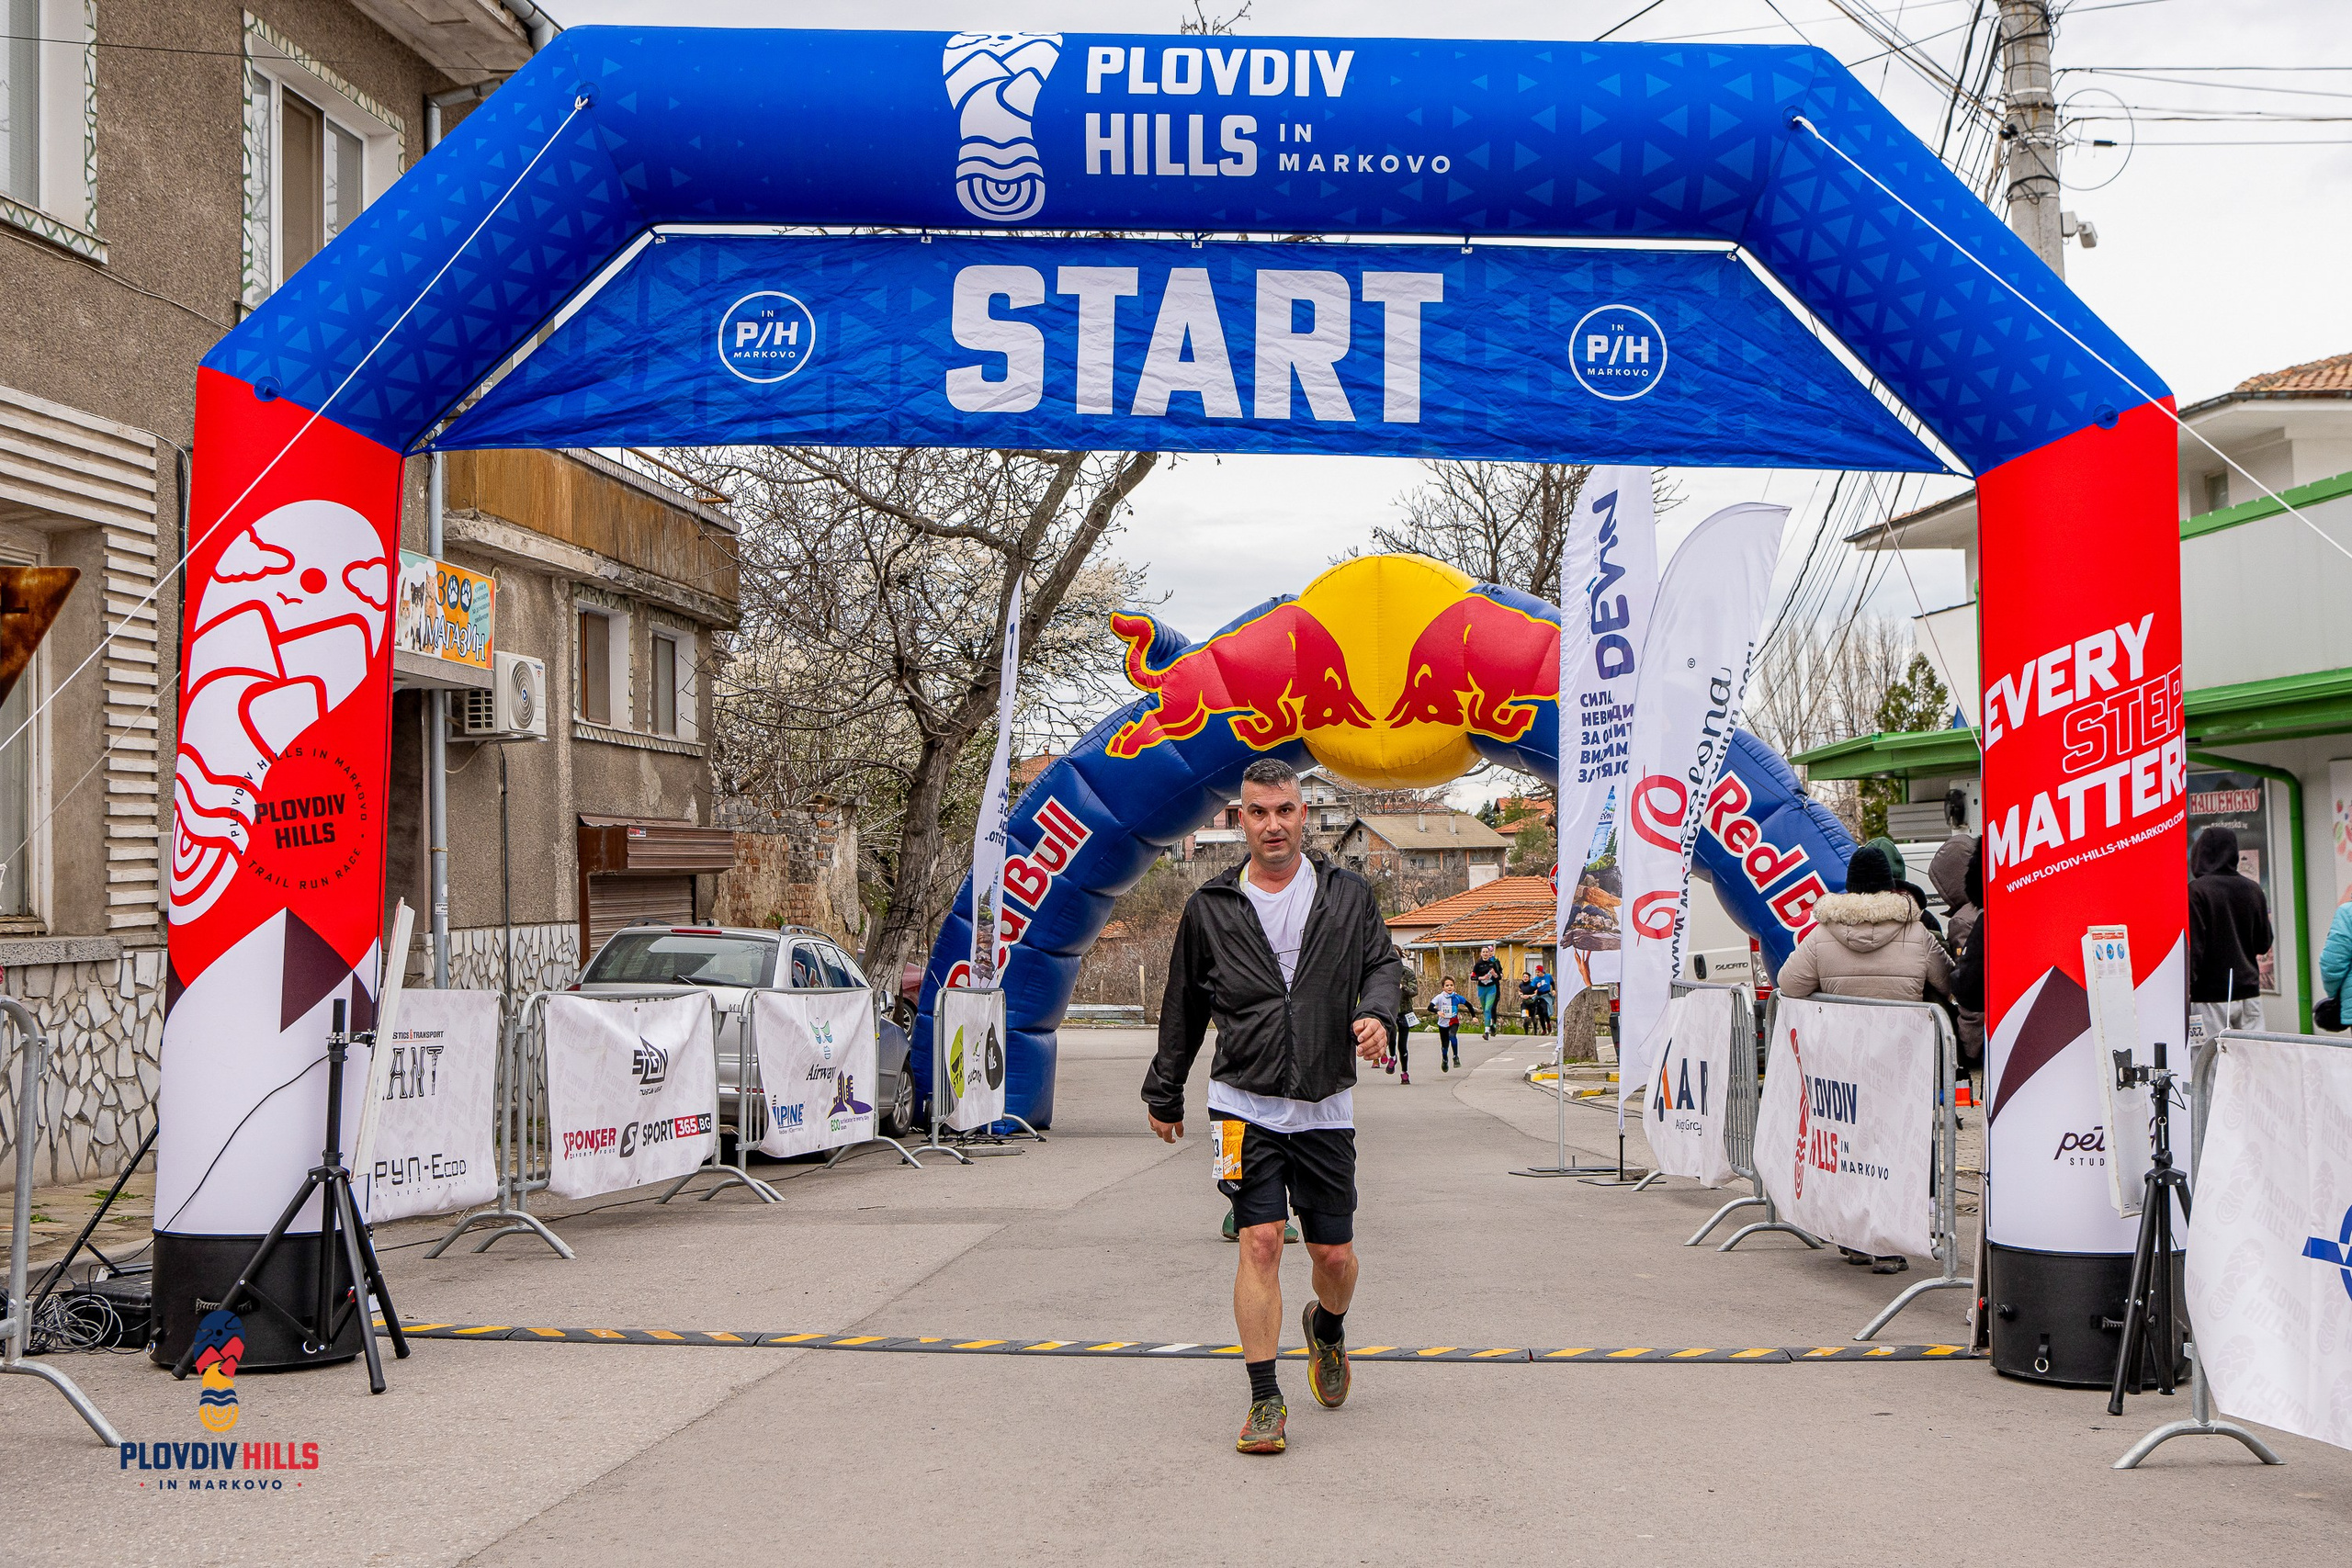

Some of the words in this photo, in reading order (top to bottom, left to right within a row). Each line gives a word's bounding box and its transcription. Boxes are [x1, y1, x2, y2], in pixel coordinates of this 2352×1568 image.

[1086, 46, 1355, 97] PLOVDIV
[1085, 113, 1258, 177] HILLS
[1279, 123, 1313, 143] IN
[1279, 153, 1452, 174] MARKOVO
[761, 310, 775, 318] IN
[1611, 323, 1624, 332] IN
[736, 321, 799, 348] P/H
[945, 265, 1444, 423] START
[1587, 334, 1649, 366] P/H
[1587, 368, 1649, 377] MARKOVO
[1590, 490, 1635, 681] DEVIN
[424, 615, 485, 661] МАГАЗИН
[1985, 613, 2154, 751] EVERY
[2063, 664, 2181, 773] STEP
[1581, 731, 1600, 745] ЗА
[230, 772, 254, 838] PLOVDIV
[256, 747, 303, 770] HILLS
[312, 748, 328, 760] IN
[334, 757, 367, 820] MARKOVO
[2189, 789, 2260, 816] НАШЕНСКО
[254, 794, 345, 825] PLOVDIV
[275, 822, 335, 850] HILLS
[1704, 774, 1805, 889] Red
[248, 860, 289, 888] TRAIL
[300, 877, 329, 890] RUN
[335, 848, 361, 879] RACE
[1003, 800, 1088, 907] Bull
[382, 1045, 445, 1100] ANT
[806, 1064, 837, 1084] Airway
[1840, 1140, 1849, 1154] IN
[1840, 1159, 1889, 1180] MARKOVO
